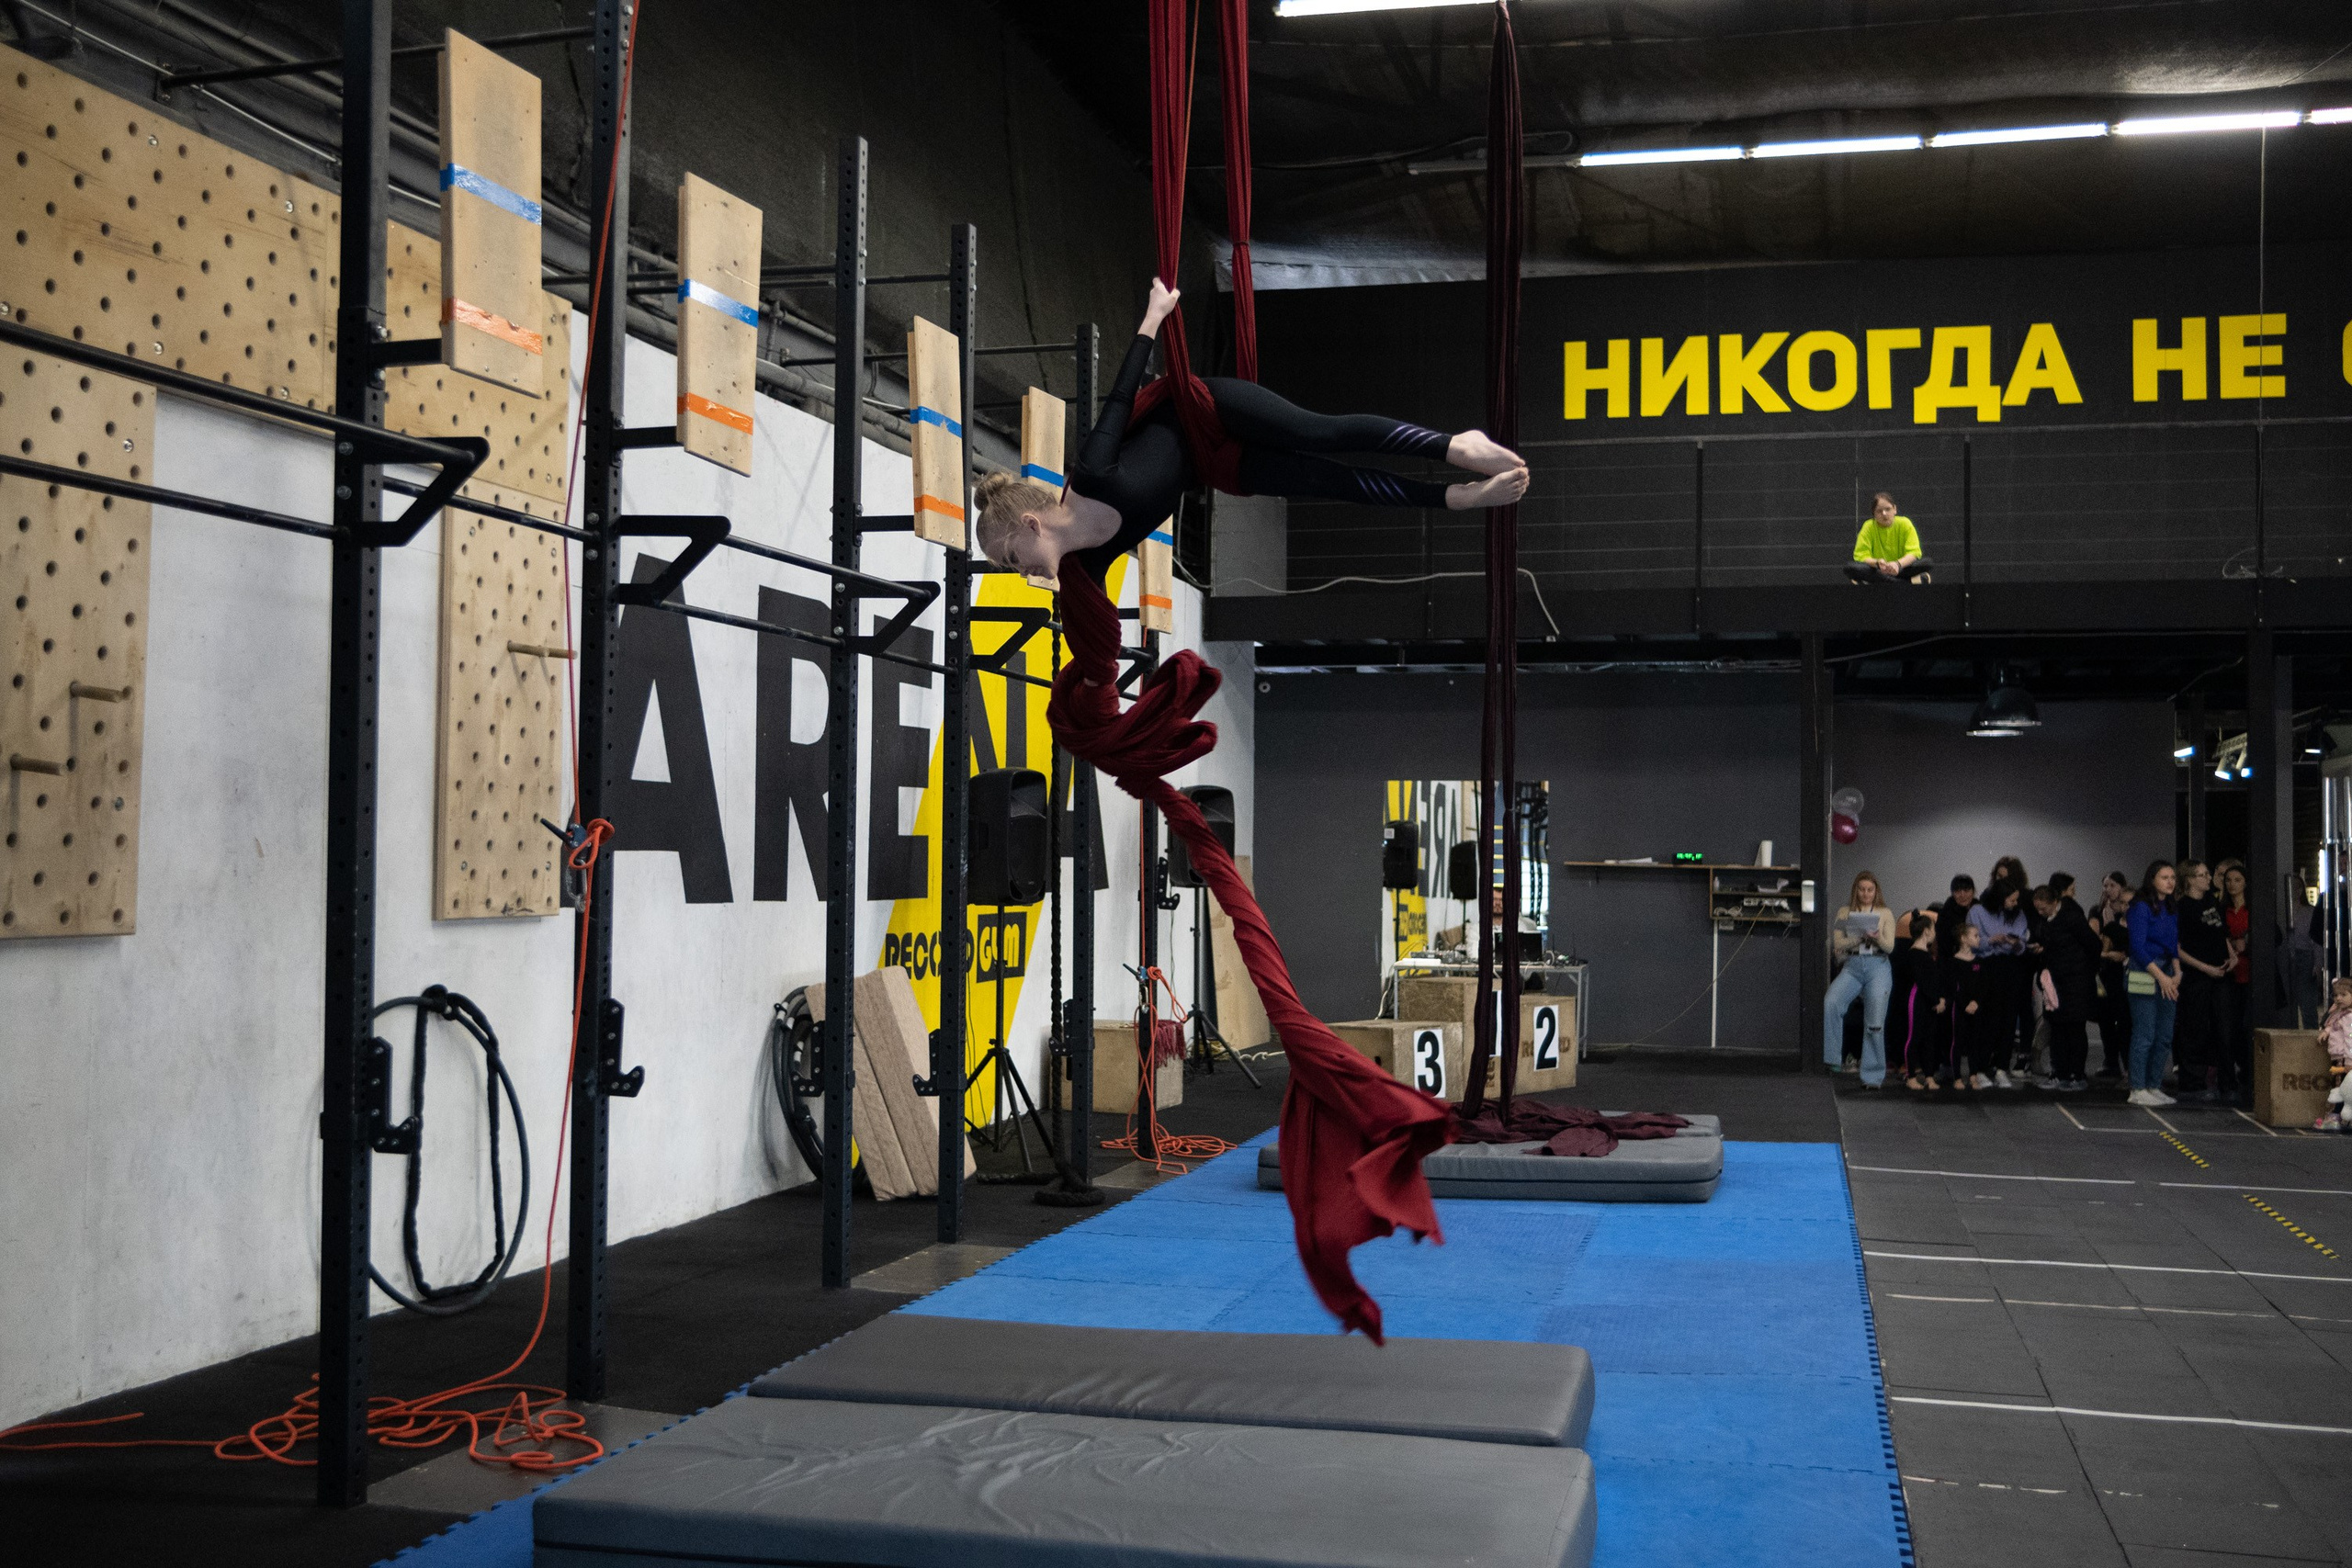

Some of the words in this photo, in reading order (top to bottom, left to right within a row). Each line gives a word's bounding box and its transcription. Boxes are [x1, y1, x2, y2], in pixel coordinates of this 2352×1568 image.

[1564, 322, 2083, 423] НИКОГДА
[2132, 312, 2287, 401] НЕ
[885, 929, 974, 980] RECOD
[1418, 1031, 1442, 1098] 3
[1536, 1007, 1557, 1070] 2
